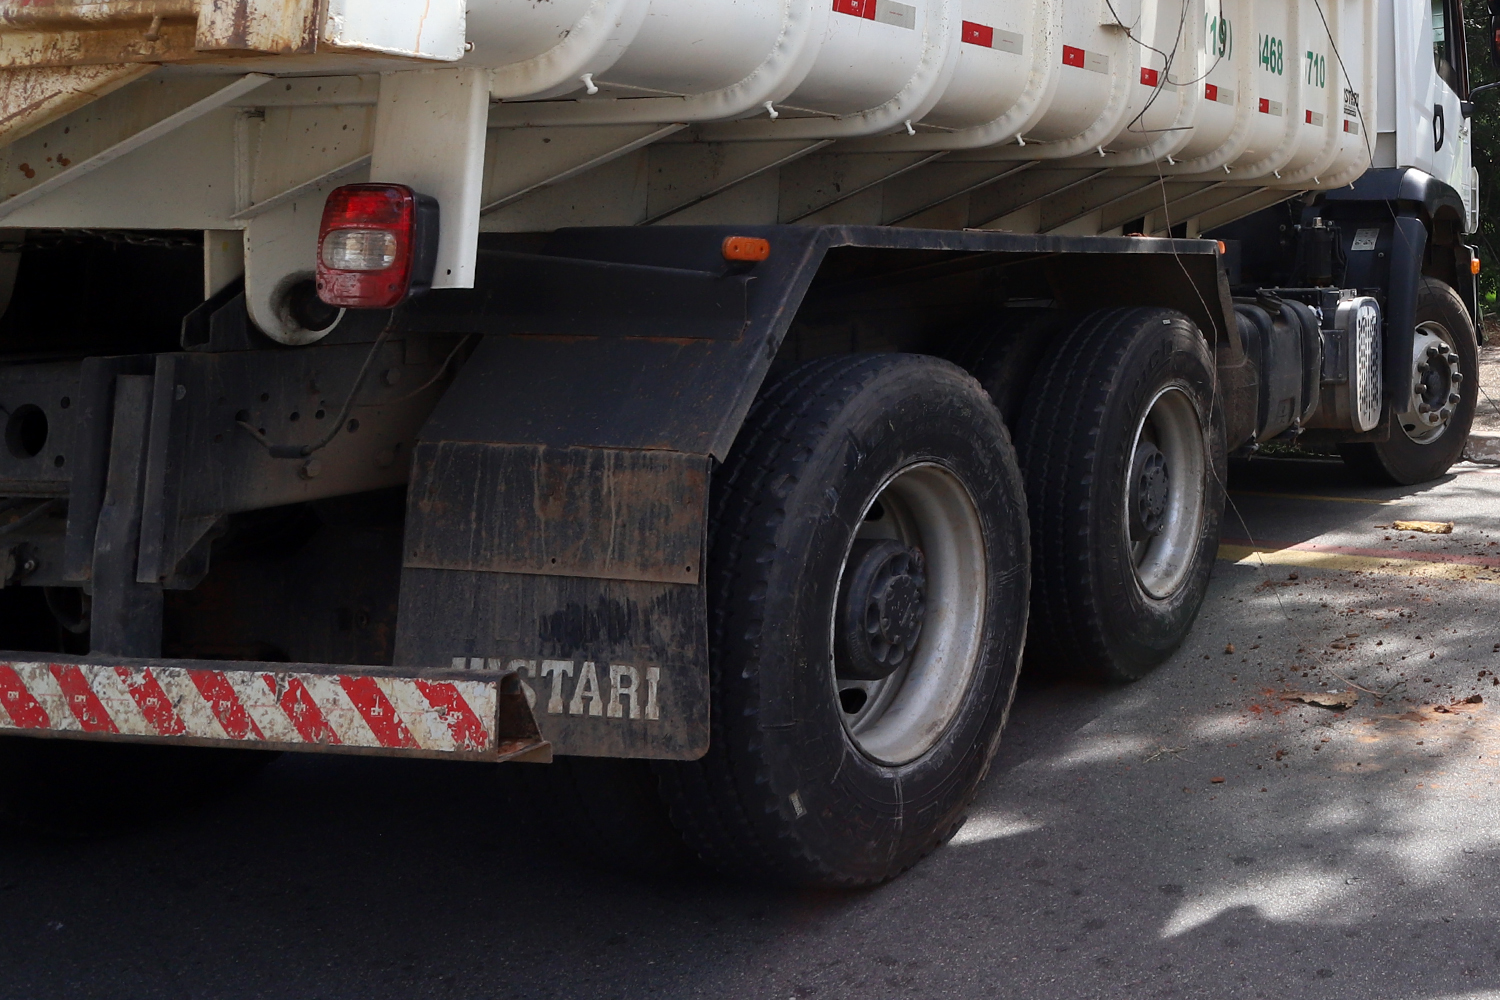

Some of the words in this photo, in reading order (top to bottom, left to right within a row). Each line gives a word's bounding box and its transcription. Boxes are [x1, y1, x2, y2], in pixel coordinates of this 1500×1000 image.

[1204, 12, 1233, 61] (19)
[1258, 33, 1283, 76] 468
[1305, 50, 1325, 88] 710
[451, 656, 660, 720] STARI
